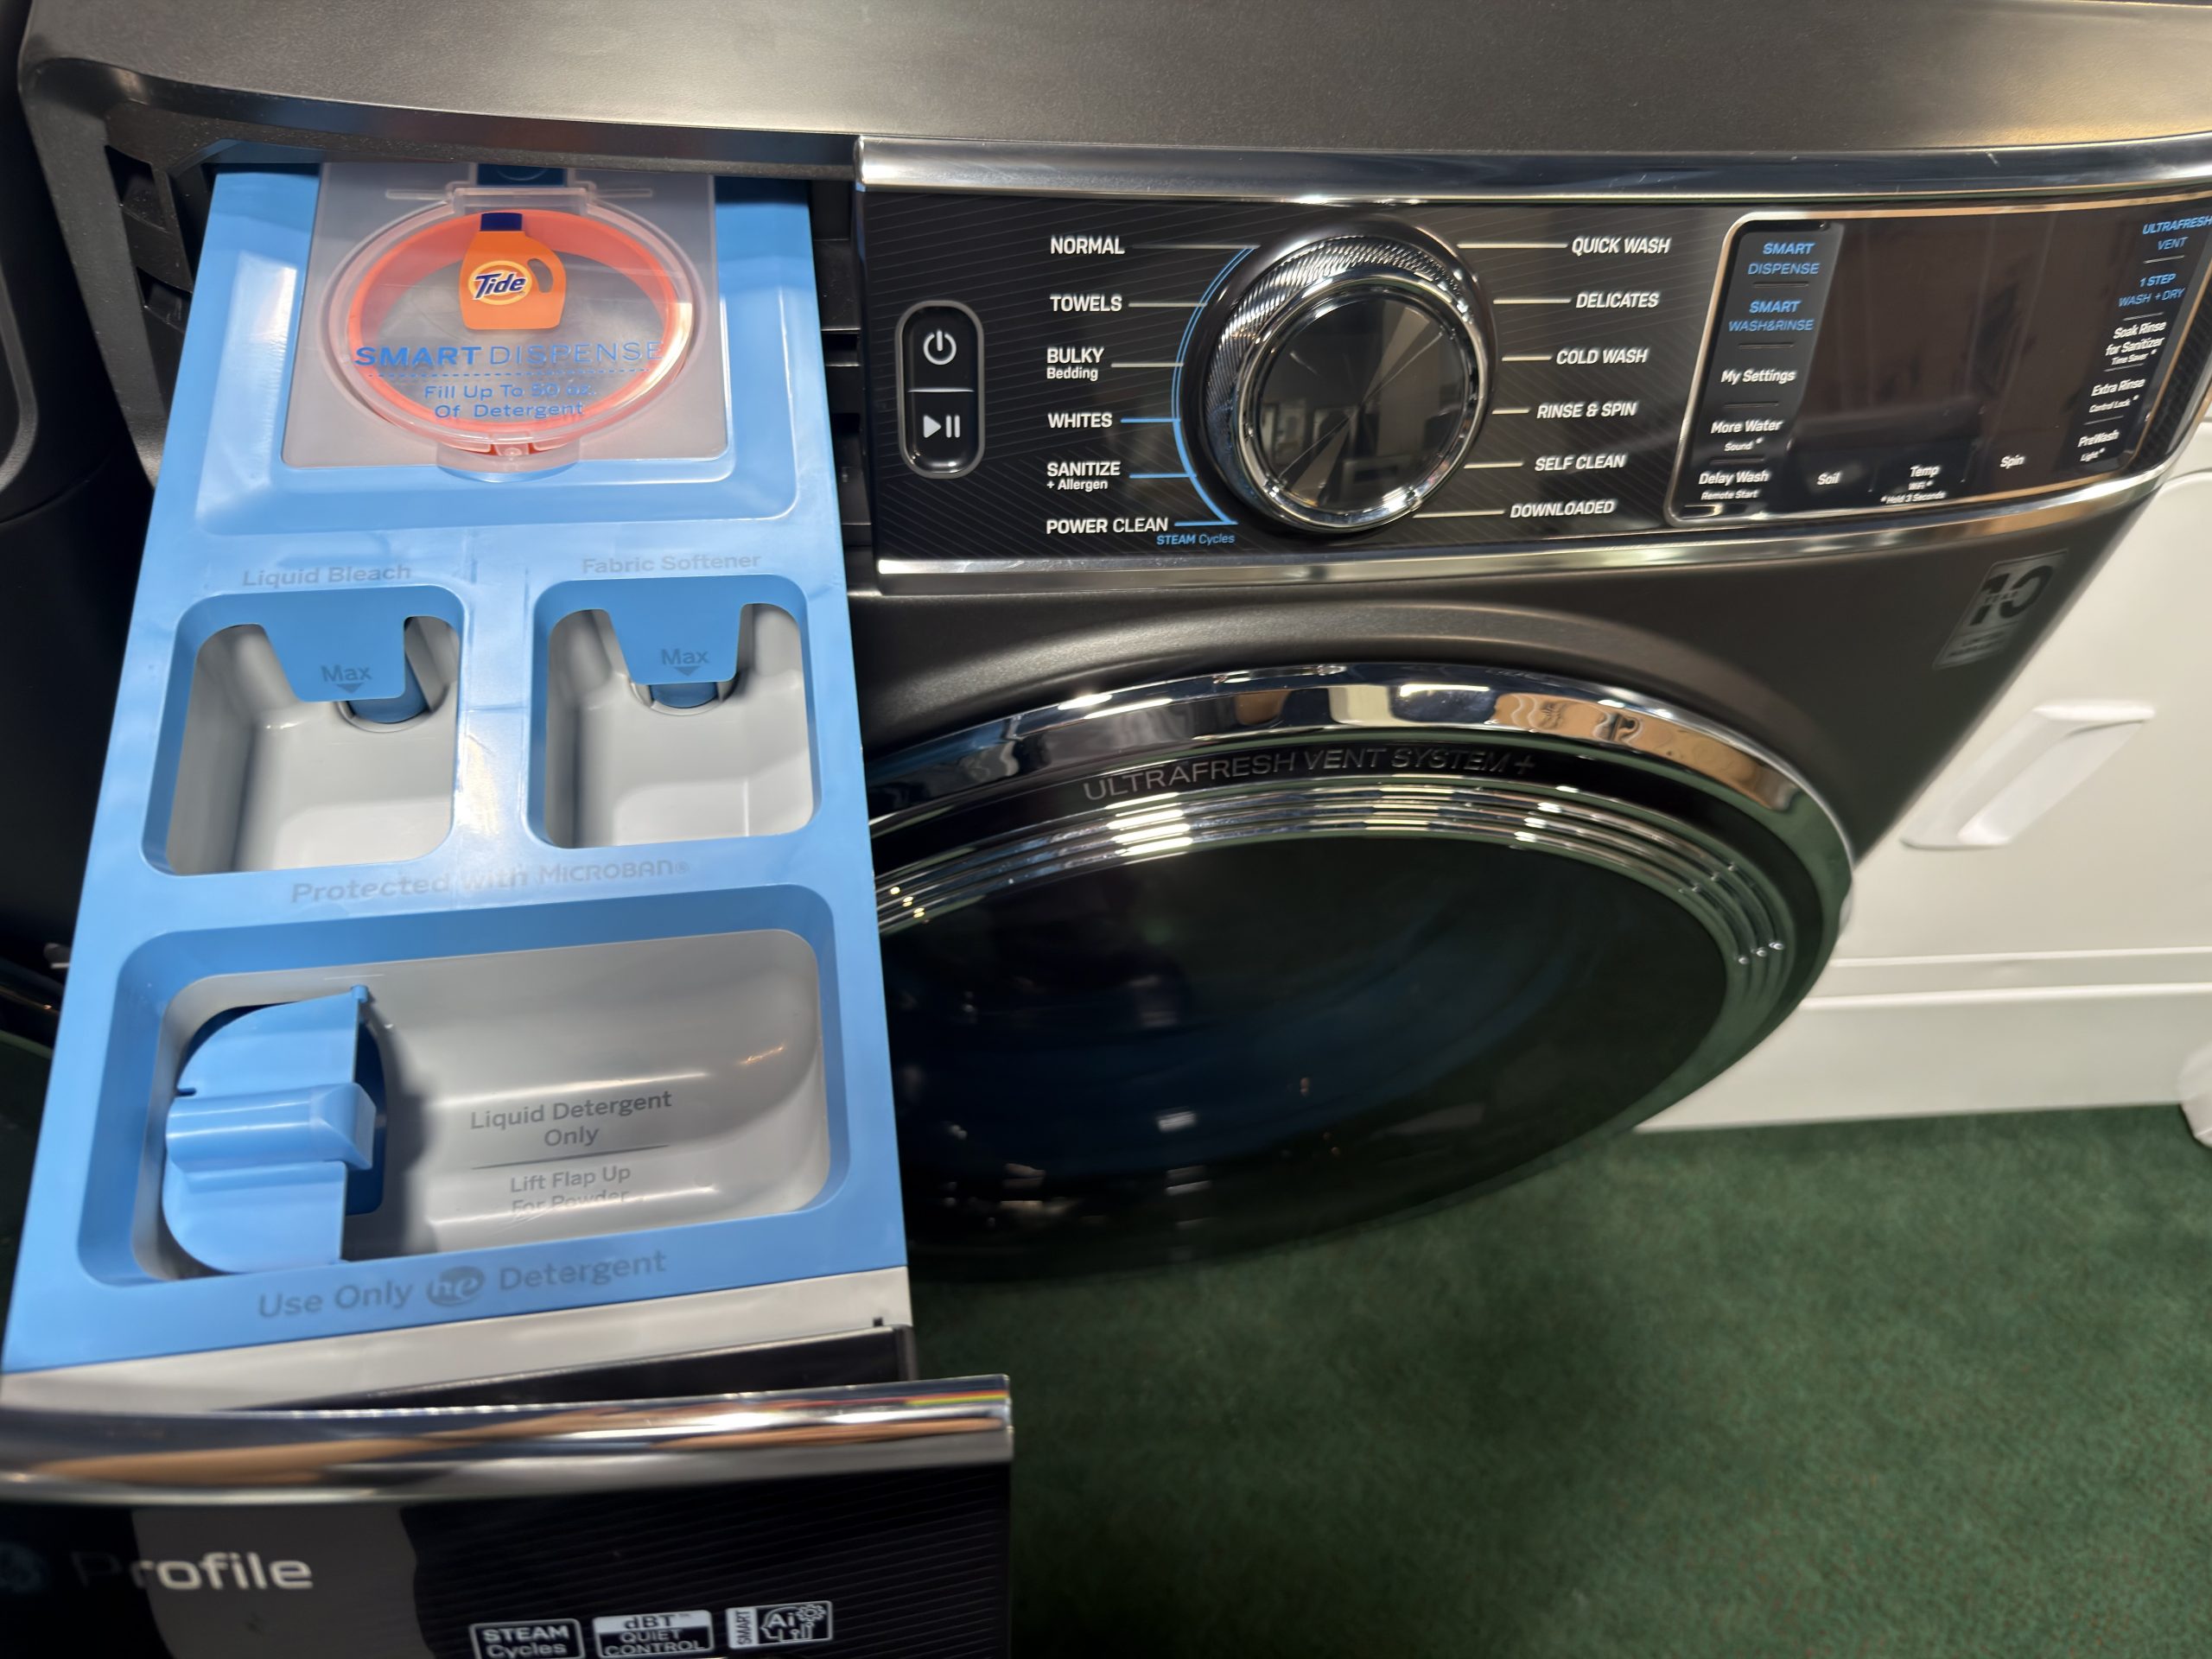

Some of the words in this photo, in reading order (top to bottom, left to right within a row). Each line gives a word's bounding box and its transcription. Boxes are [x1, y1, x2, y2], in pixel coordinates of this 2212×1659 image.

[2143, 215, 2212, 234] ULTRAFRESH
[1050, 236, 1125, 255] NORMAL
[1572, 237, 1620, 257] QUICK
[1624, 237, 1672, 254] WASH
[1763, 242, 1815, 255] SMART
[2158, 237, 2189, 251] VENT
[1747, 263, 1821, 275] DISPENSE
[474, 272, 527, 300] Tide
[2139, 277, 2146, 287] 1
[2147, 274, 2176, 287] STEP
[1050, 294, 1122, 312] TOWELS
[1576, 291, 1660, 308] DELICATES
[1749, 300, 1802, 314] SMART
[2119, 293, 2152, 307] WASH
[1728, 319, 1815, 332] WASH&RINSE
[2113, 324, 2139, 340] Soak
[2139, 321, 2167, 335] Rinse
[354, 346, 481, 366] SMART
[490, 340, 664, 365] DISPENSE
[1046, 346, 1104, 364] BULKY
[2105, 344, 2120, 356] for
[2120, 337, 2165, 353] Sanitizer
[1556, 348, 1599, 365] COLD
[1603, 347, 1649, 364] WASH
[1046, 366, 1098, 381] Bedding
[1721, 369, 1741, 385] My
[1743, 368, 1797, 385] Settings
[424, 385, 455, 399] Fill
[463, 385, 493, 401] Up
[499, 384, 524, 398] To
[2091, 385, 2118, 397] Extra
[2118, 378, 2146, 391] Rinse
[435, 404, 461, 418] Of
[474, 402, 583, 419] Detergent
[1537, 402, 1584, 419] RINSE
[1586, 402, 1599, 418] &
[1601, 400, 1639, 417] SPIN
[1047, 412, 1113, 429] WHITES
[1711, 420, 1743, 434] More
[1745, 419, 1783, 432] Water
[1724, 441, 1753, 452] Sound
[2077, 429, 2120, 448] PreWash
[1046, 461, 1122, 477] SANITIZE
[1535, 455, 1573, 472] SELF
[1575, 454, 1627, 470] CLEAN
[2000, 454, 2025, 469] Spin
[1699, 472, 1734, 486] Delay
[1736, 469, 1771, 483] Wash
[1817, 471, 1842, 485] Soil
[1910, 464, 1942, 478] Temp
[1058, 478, 1108, 492] Allergen
[1510, 499, 1618, 518] DOWNLOADED
[1046, 518, 1108, 535] POWER
[1112, 518, 1168, 533] CLEAN
[1156, 534, 1196, 545] STEAM
[1198, 533, 1235, 546] Cycles
[582, 556, 654, 574] Fabric
[660, 554, 761, 571] Softener
[243, 568, 320, 589] Liquid
[327, 563, 410, 583] Bleach
[661, 647, 709, 667] Max
[321, 663, 372, 683] Max
[1083, 753, 1294, 801] ULTRAFRESH
[1304, 747, 1385, 772] VENT
[1390, 748, 1508, 773] SYSTEM
[290, 869, 450, 904] Protected
[461, 863, 528, 891] with
[471, 1105, 544, 1130] Liquid
[552, 1090, 672, 1121] Detergent
[544, 1125, 601, 1147] Only
[511, 1171, 546, 1192] Lift
[552, 1169, 595, 1188] Flap
[602, 1166, 631, 1184] Up
[259, 1293, 322, 1319] Use
[334, 1281, 413, 1309] Only
[499, 1250, 668, 1291] Detergent
[482, 1625, 569, 1643] STEAM
[620, 1628, 682, 1643] QUIET
[735, 1611, 753, 1645] SMART
[486, 1642, 567, 1659] Cycles
[605, 1640, 704, 1656] CONTROL
